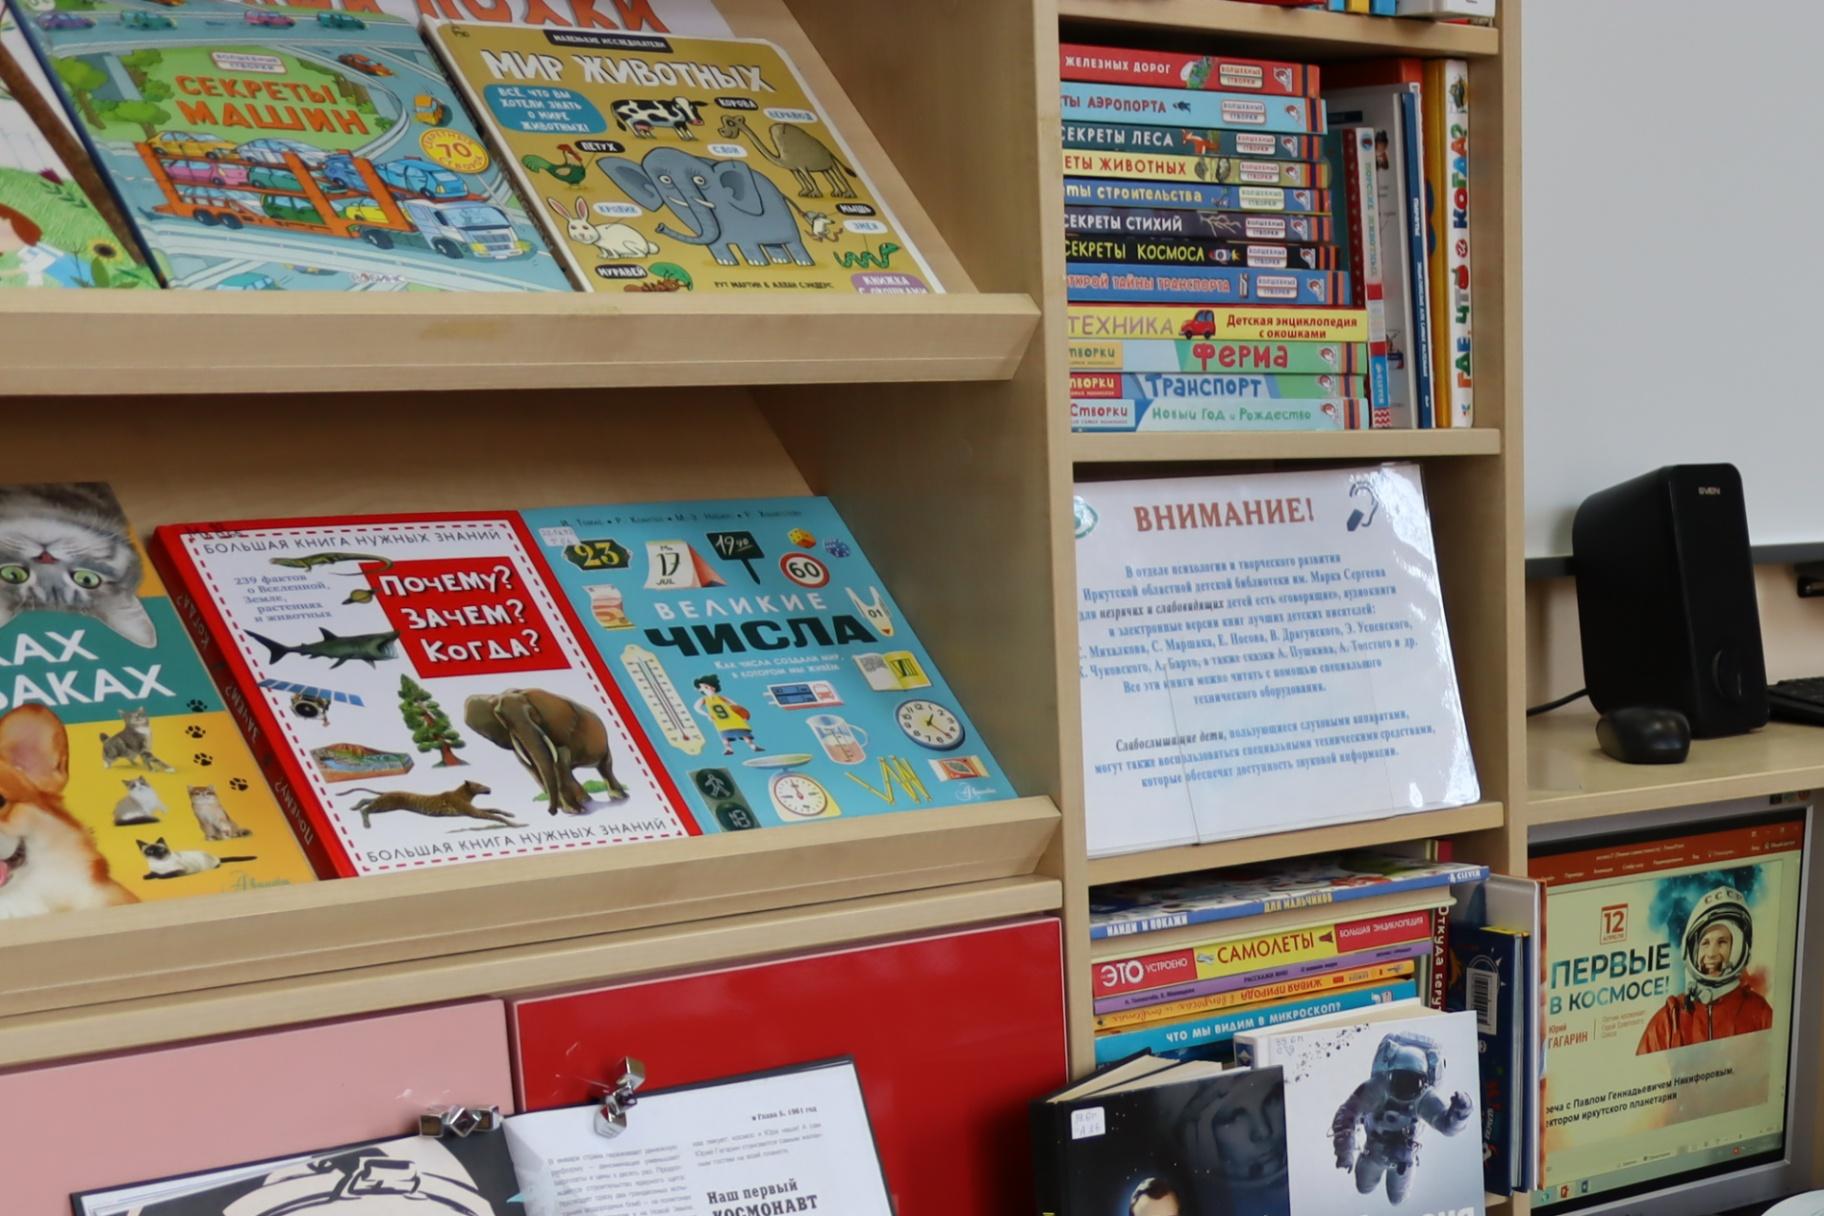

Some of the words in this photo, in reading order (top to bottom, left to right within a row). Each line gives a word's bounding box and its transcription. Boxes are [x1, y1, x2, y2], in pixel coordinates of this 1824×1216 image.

[480, 50, 564, 81] МИР
[570, 54, 777, 93] ЖИВОТНЫХ
[1065, 56, 1129, 71] ЖЕЛЕЗНЫХ
[1133, 62, 1171, 74] ДОРОГ
[176, 76, 338, 105] СЕКРЕТЫ
[554, 89, 571, 98] ВЫ
[176, 100, 370, 135] МАШИН
[1088, 98, 1166, 113] АЭРОПОРТА
[1061, 126, 1125, 144] СЕКРЕТЫ
[1132, 131, 1174, 147] ЛЕСА
[436, 143, 471, 159] 70
[1099, 157, 1186, 175] ЖИВОТНЫХ
[1064, 214, 1121, 229] СЕКРЕТЫ
[1126, 215, 1183, 232] СТИХИЙ
[1065, 241, 1126, 259] СЕКРЕТЫ
[1137, 244, 1205, 262] КОСМОСА
[1112, 273, 1155, 290] ТАЙНЫ
[1157, 277, 1230, 293] ТРАНСПОРТА
[1068, 314, 1174, 336] ТЕХНИКА
[1226, 314, 1272, 328] Детская
[1276, 317, 1358, 328] энциклопедия
[1259, 330, 1266, 338] с
[1267, 329, 1326, 339] окошками
[1145, 374, 1262, 398] Транспорт
[1698, 486, 1721, 496] SVEN
[1134, 498, 1314, 533] ВНИМАНИЕ!
[203, 539, 289, 554] БОЛЬШАЯ
[296, 534, 350, 549] КНИГА
[355, 532, 429, 547] НУЖНЫХ
[437, 529, 501, 542] ЗНАНИЙ
[573, 542, 620, 567] 23
[656, 552, 681, 577] 17
[656, 577, 676, 586] JUL
[788, 560, 821, 579] 60
[400, 598, 525, 629] ЗАЧЕМ?
[654, 592, 828, 620] ВЕЛИКИЕ
[0, 629, 99, 666] АХ
[643, 615, 878, 657] ЧИСЛА
[0, 664, 177, 710] АКАХ
[715, 704, 729, 719] 9
[366, 840, 453, 865] БОЛЬШАЯ
[457, 834, 517, 853] КНИГА
[519, 825, 596, 847] НУЖНЫХ
[601, 816, 667, 836] ЗНАНИЙ
[1604, 911, 1625, 934] 12
[1100, 960, 1145, 988] ЭТО
[1146, 958, 1188, 974] УСТРОЕНО
[1217, 930, 1315, 964] САМОЛЕТЫ
[1339, 925, 1371, 938] БОЛЬШАЯ
[1373, 916, 1424, 933] ЭНЦИКЛОПЕДИЯ
[1550, 942, 1671, 990] ПЕРВЫЕ
[1550, 996, 1562, 1015] В
[1568, 976, 1670, 1012] КОСМОСЕ!
[1166, 1031, 1188, 1043] ЧТО
[1192, 1026, 1212, 1038] МЫ
[1215, 1018, 1254, 1034] ВИДИМ
[1258, 1016, 1265, 1025] В
[1269, 1002, 1341, 1024] МИКРОСКОП?
[1548, 1030, 1588, 1049] ГАГАРИН
[1573, 1095, 1606, 1109] Павлом
[1608, 1080, 1672, 1100] Геннадьевичем
[1582, 1102, 1628, 1120] иркутского
[707, 1190, 739, 1204] Наш
[743, 1178, 798, 1200] первый
